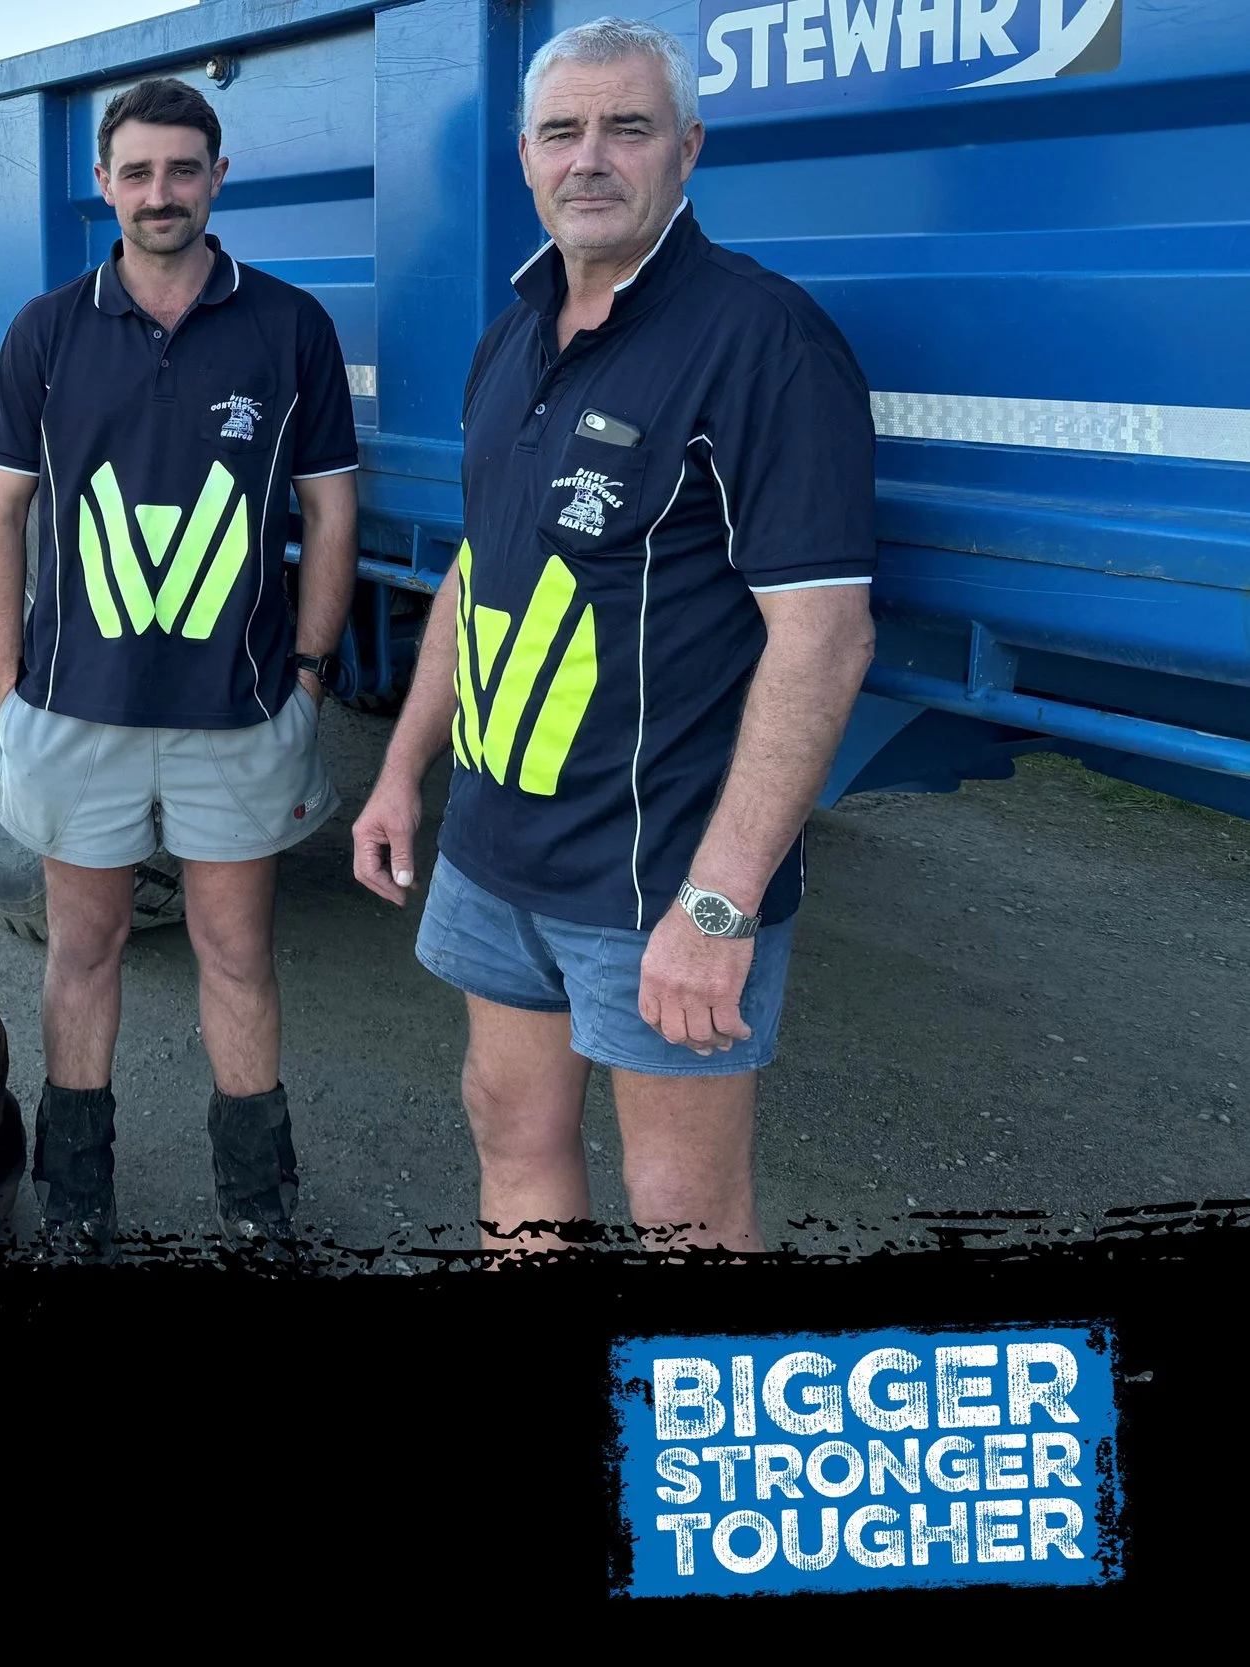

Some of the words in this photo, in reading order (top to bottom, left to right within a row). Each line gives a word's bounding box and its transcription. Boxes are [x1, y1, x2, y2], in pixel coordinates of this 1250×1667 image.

[211, 400, 262, 420] CONTRACTORS
[551, 477, 624, 508] CONTRACTORS
[557, 516, 603, 537] MARTON
